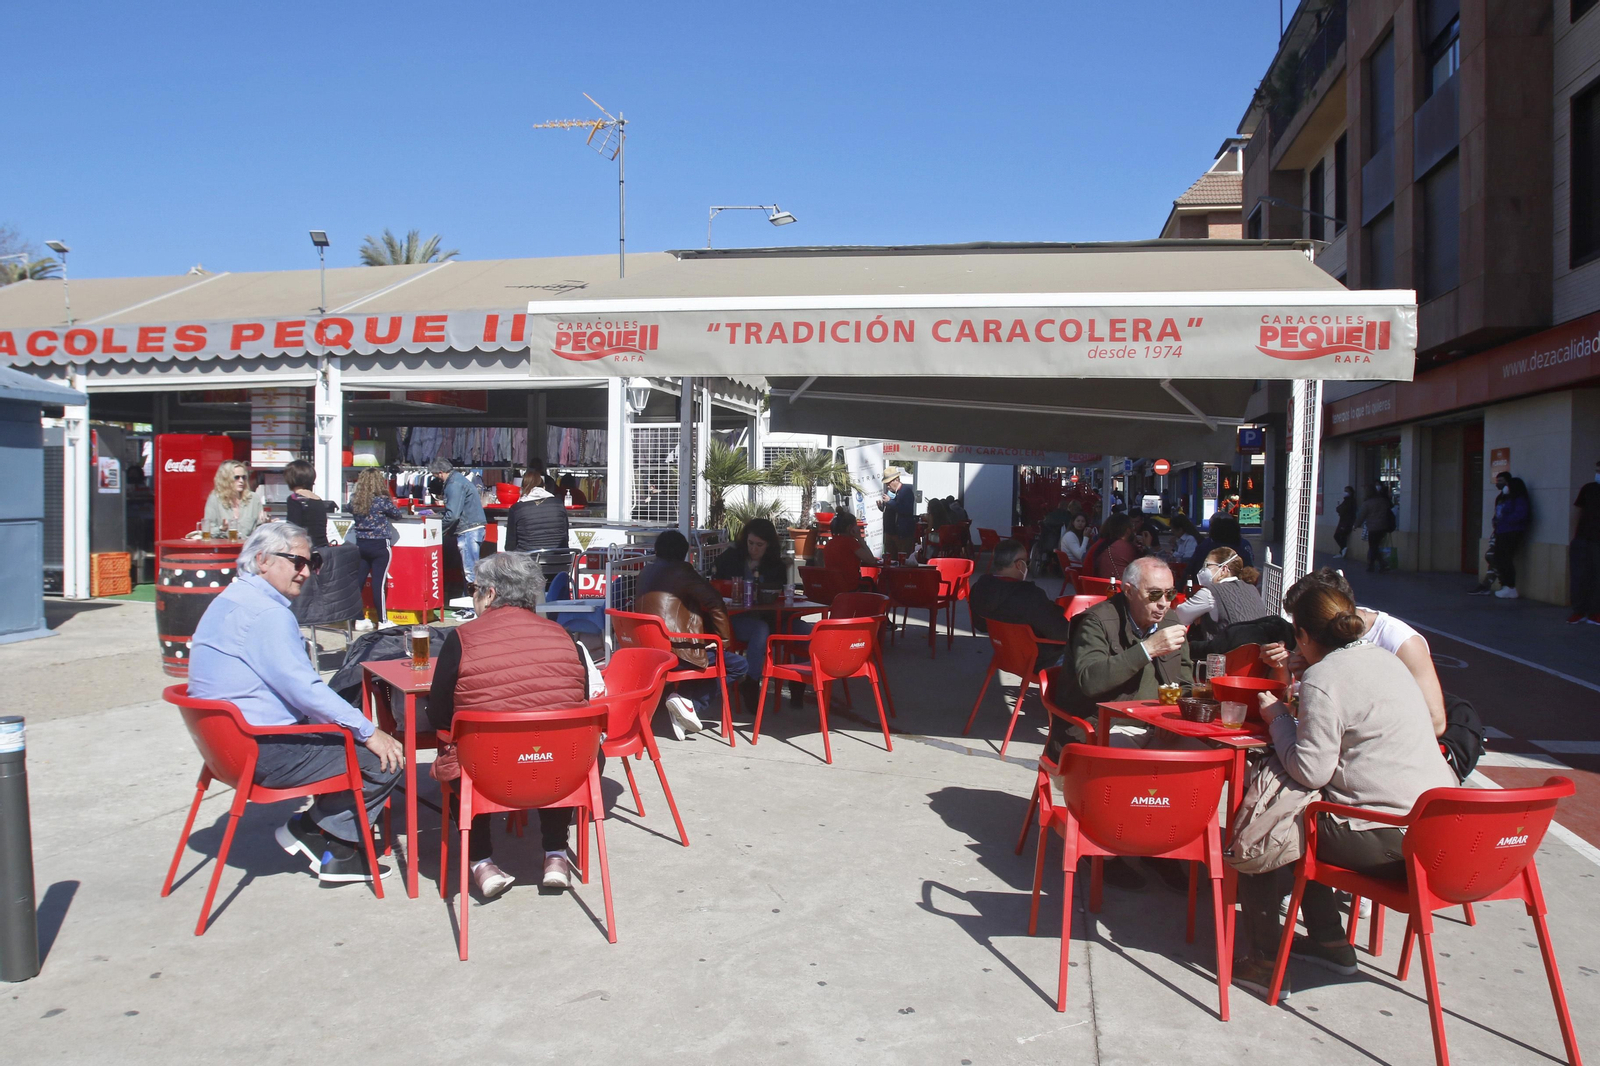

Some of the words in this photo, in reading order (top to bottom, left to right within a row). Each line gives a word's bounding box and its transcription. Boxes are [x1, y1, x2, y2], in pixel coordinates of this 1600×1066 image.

[557, 321, 638, 331] CARACOLES
[1261, 315, 1364, 325] CARACOLES
[230, 315, 448, 350] PEQUE
[1088, 345, 1140, 359] desde
[1143, 345, 1183, 359] 1974
[1502, 331, 1600, 378] www.dezacalidad
[1334, 355, 1371, 363] RAFA
[1246, 431, 1256, 444] P
[431, 550, 439, 599] AMBAR
[517, 752, 554, 762] AMBAR
[1130, 796, 1170, 805] AMBAR
[1496, 835, 1529, 847] AMBAR
